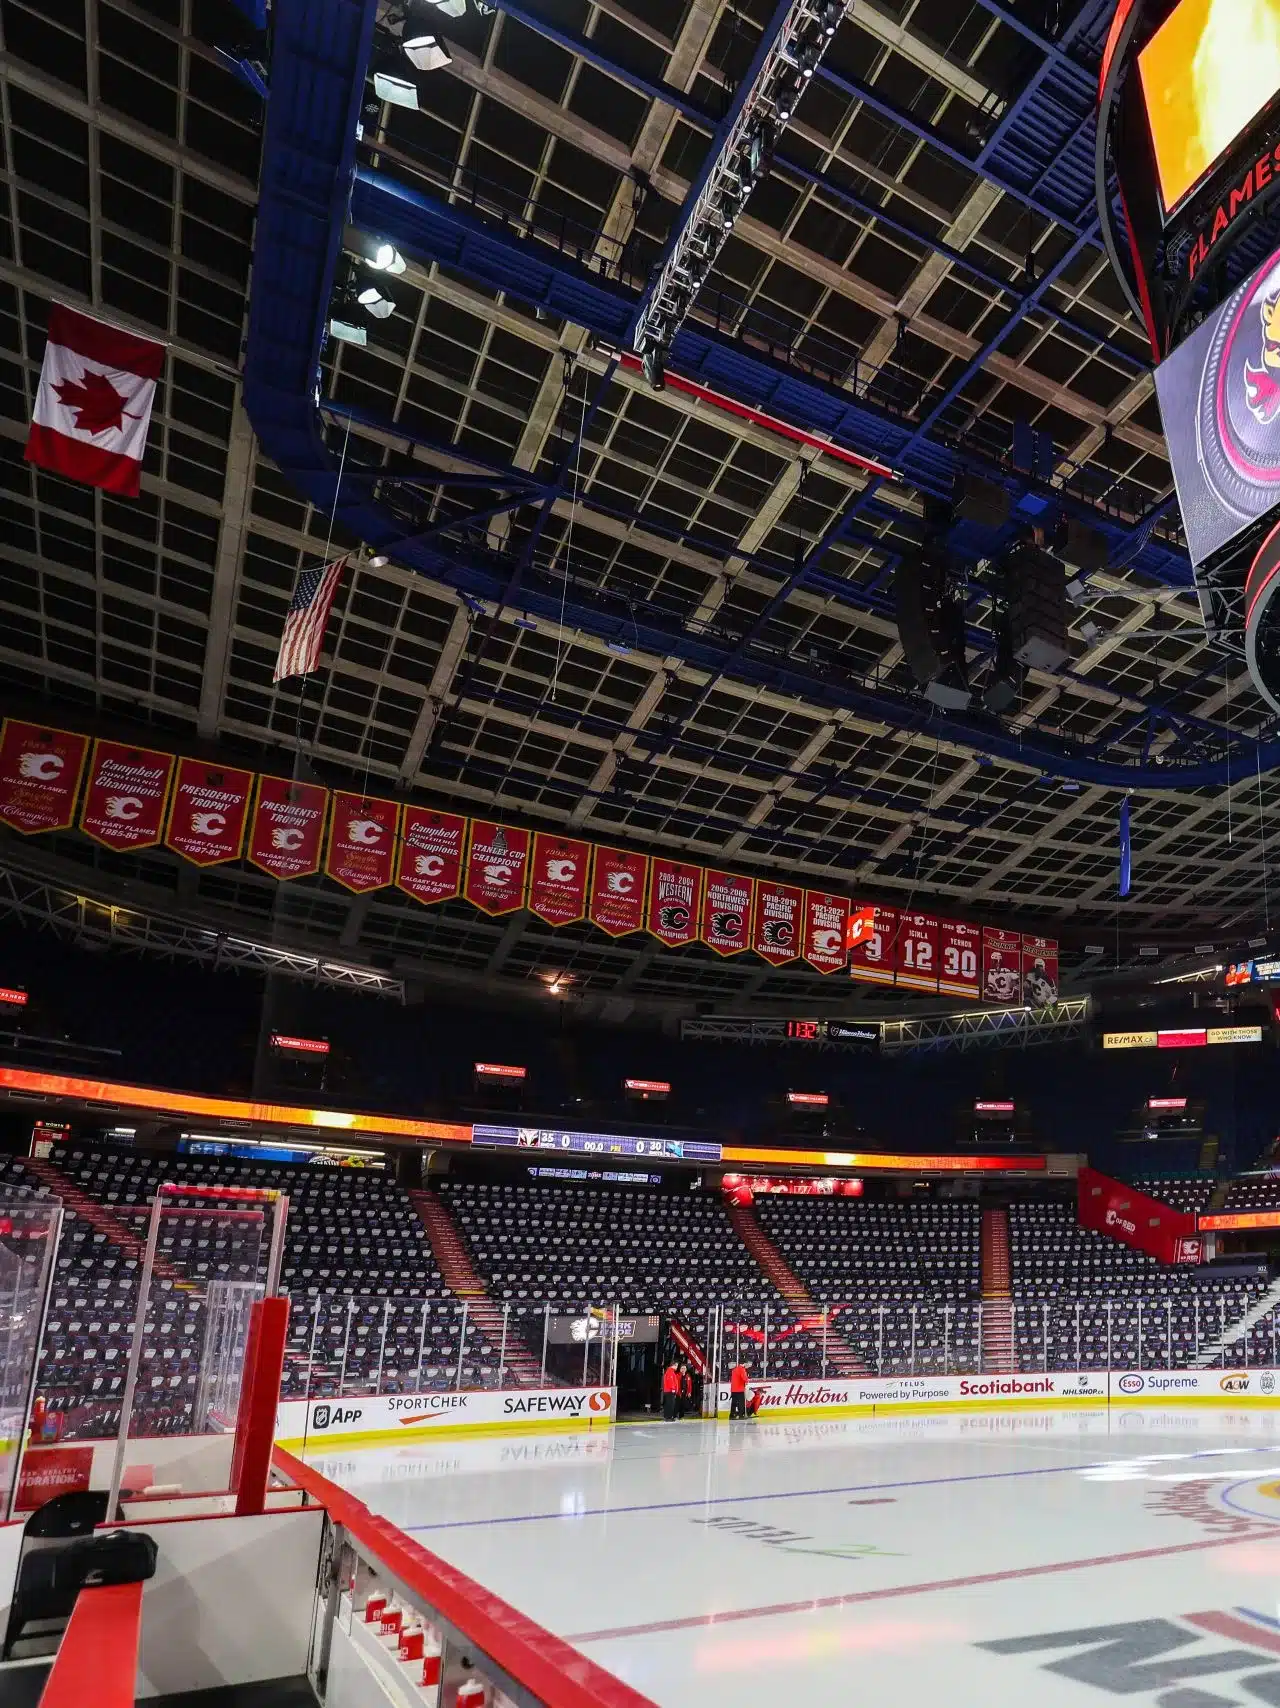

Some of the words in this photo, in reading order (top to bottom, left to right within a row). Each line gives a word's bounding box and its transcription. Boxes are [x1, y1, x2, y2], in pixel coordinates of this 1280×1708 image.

[101, 759, 164, 780] Campbell
[3, 776, 37, 788] CALGARY
[38, 784, 68, 795] FLAMES
[95, 776, 162, 798] Champions
[190, 796, 231, 812] TROPHY
[86, 817, 123, 830] CALGARY
[124, 824, 156, 835] FLAMES
[270, 813, 309, 827] TROPHY
[100, 827, 138, 840] 1985-86
[410, 822, 460, 840] Campbell
[175, 836, 205, 847] CALGARY
[206, 842, 233, 852] FLAMES
[184, 845, 221, 857] 1987-88
[336, 842, 363, 852] CALGARY
[364, 848, 387, 856] FLAMES
[406, 837, 459, 856] Champions
[256, 851, 285, 861] CALGARY
[286, 856, 312, 866] FLAMES
[472, 843, 508, 857] STANLEY
[509, 850, 526, 860] CUP
[472, 853, 522, 869] CHAMPIONS
[400, 875, 430, 885] CALGARY
[430, 880, 456, 890] FLAMES
[412, 883, 442, 894] 1988-89
[537, 880, 560, 889] CALGARY
[597, 892, 618, 901] CALGARY
[658, 882, 692, 907] WESTERN
[711, 884, 748, 898] 2005-2006
[707, 891, 750, 907] NORTHWEST
[762, 893, 797, 907] 2018-2019
[535, 902, 577, 918] Champions
[712, 901, 744, 913] DIVISION
[766, 901, 792, 913] PACIFIC
[811, 903, 845, 917] 2021-2022
[595, 913, 636, 929] Champions
[763, 908, 794, 921] DIVISION
[815, 911, 840, 923] PACIFIC
[813, 918, 841, 930] DIVISION
[656, 928, 689, 940] CHAMPIONS
[999, 931, 1005, 940] 2
[707, 936, 743, 949] CHAMPIONS
[865, 932, 882, 961] 9
[950, 937, 972, 948] VERNON
[1035, 938, 1046, 947] 25
[757, 943, 795, 957] CHAMPIONS
[904, 939, 933, 971] 12
[807, 952, 843, 966] CHAMPIONS
[944, 947, 977, 979] 30
[541, 1132, 554, 1143] 35
[561, 1134, 571, 1147] 0
[584, 1141, 603, 1151] 00.0
[636, 1140, 645, 1153] 0
[649, 1141, 662, 1151] 30
[1122, 1220, 1136, 1232] RED
[900, 1380, 925, 1388] TELUS
[959, 1377, 1055, 1396] Scotiabank
[1122, 1379, 1141, 1389] Esso
[1147, 1376, 1199, 1389] Supreme
[1225, 1381, 1250, 1390] A&W
[784, 1383, 848, 1406] Hortons
[859, 1390, 899, 1400] Powered
[899, 1389, 911, 1400] by
[912, 1389, 950, 1399] Purpose
[503, 1394, 587, 1414] SAFEWAY
